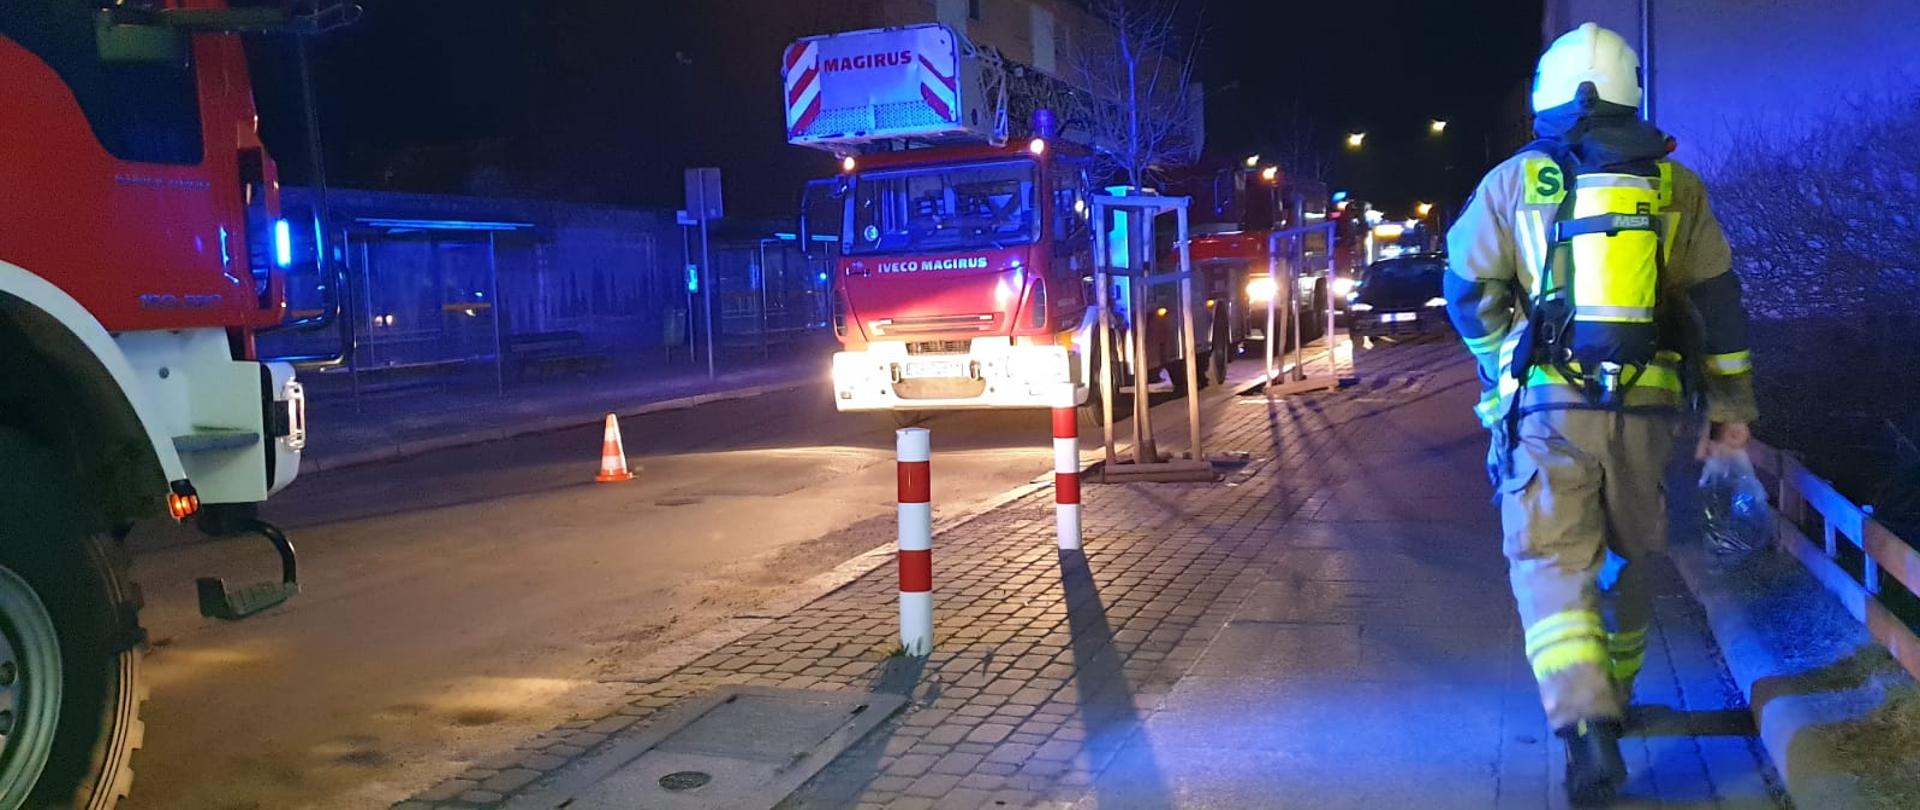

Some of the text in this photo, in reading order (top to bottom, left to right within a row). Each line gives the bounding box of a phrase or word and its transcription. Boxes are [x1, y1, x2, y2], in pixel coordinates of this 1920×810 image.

[824, 50, 912, 72] MAGIRUS
[878, 257, 988, 273] IVECO MAGIRUS
